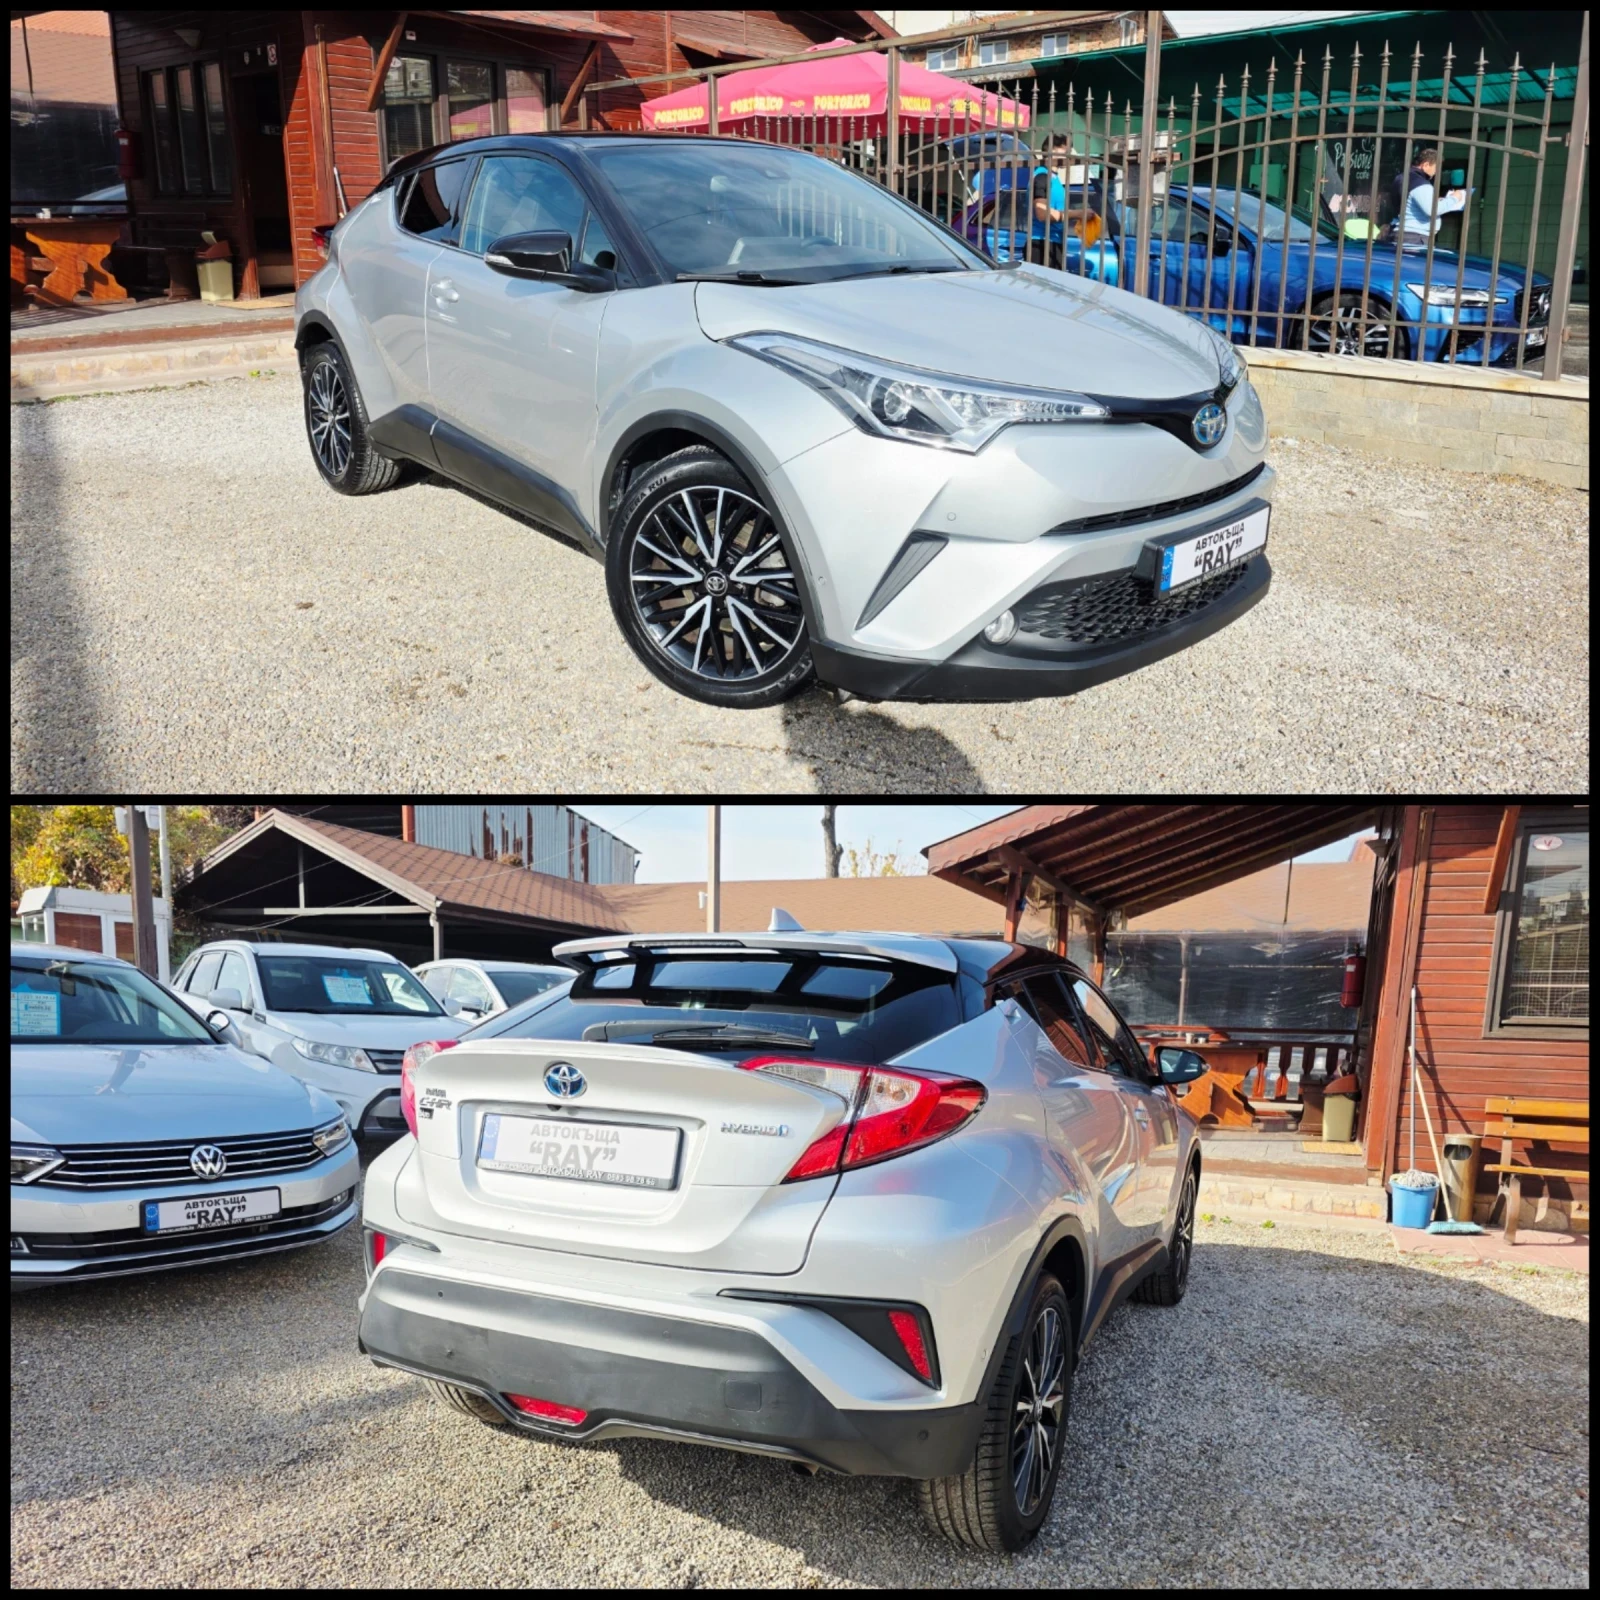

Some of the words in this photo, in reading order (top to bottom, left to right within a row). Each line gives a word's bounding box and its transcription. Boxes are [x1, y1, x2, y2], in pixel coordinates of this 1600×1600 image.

[730, 96, 783, 114] PORTORICO
[813, 94, 870, 110] PORTORICO
[654, 106, 704, 124] PORTORICO
[1195, 522, 1245, 552] АВТОКЪЩА
[530, 1123, 621, 1145] АВТОКЪЩА
[720, 1122, 778, 1137] HYBRID
[184, 1195, 248, 1211] АВТОКЪЩА
